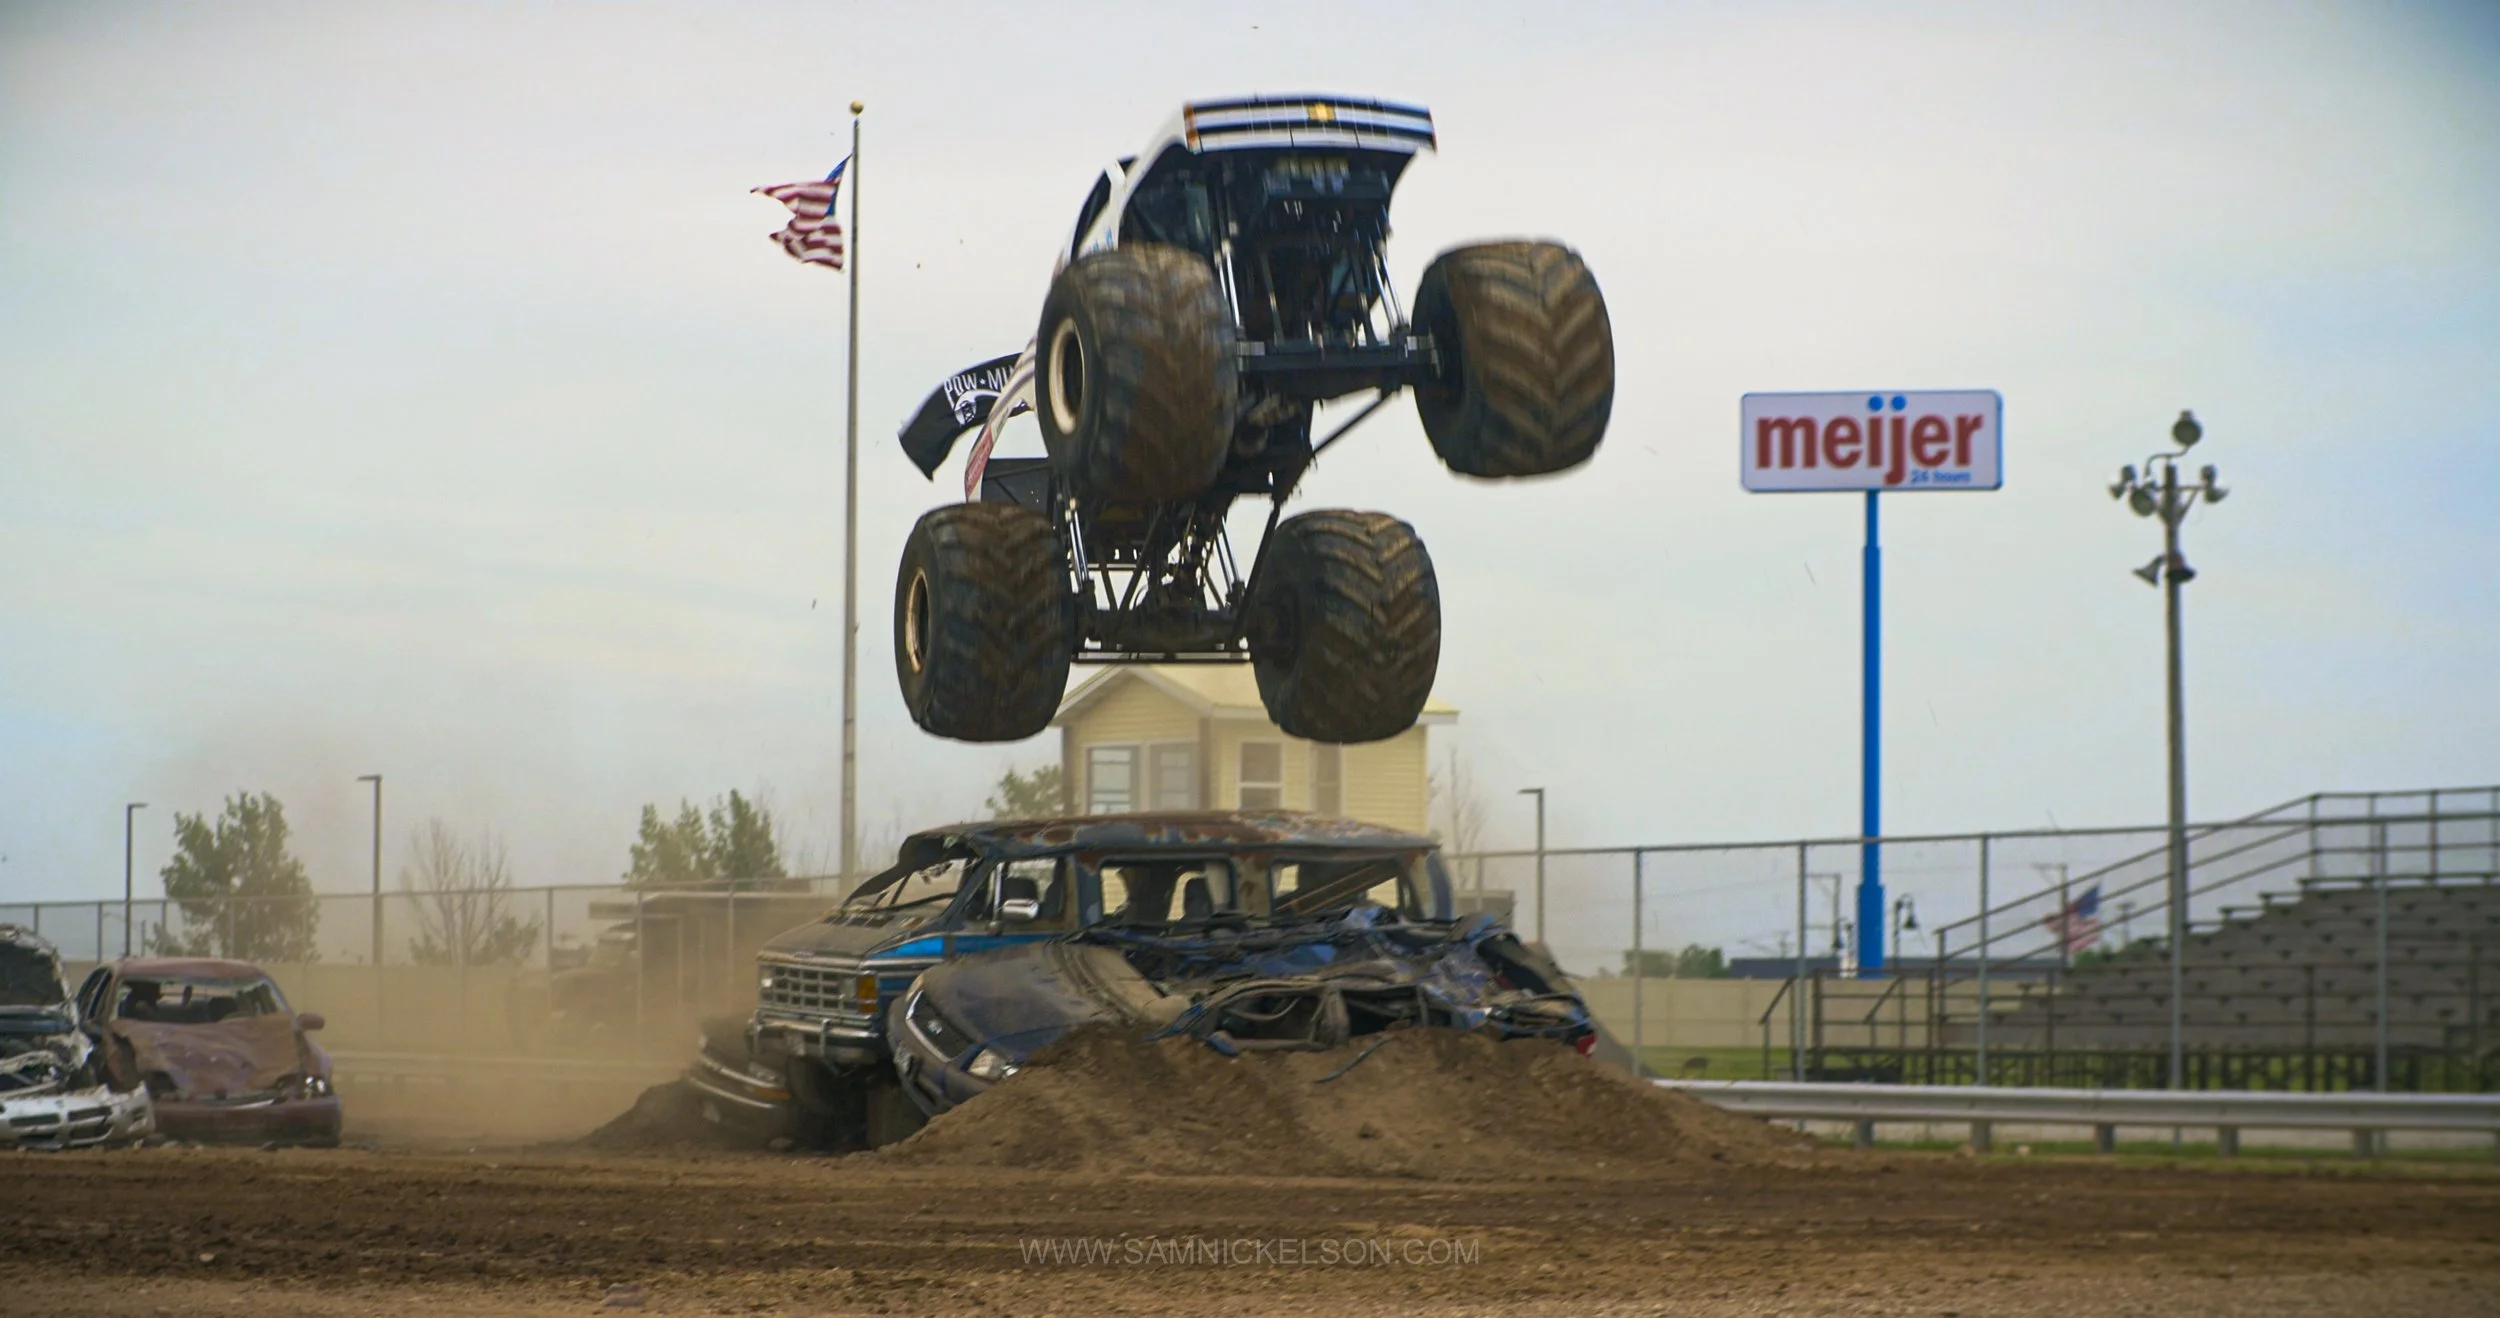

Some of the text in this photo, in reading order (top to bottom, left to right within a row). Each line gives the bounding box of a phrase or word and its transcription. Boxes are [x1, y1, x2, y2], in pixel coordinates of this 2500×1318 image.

[944, 373, 977, 409] POW
[1756, 395, 1984, 485] meijer
[1911, 469, 1929, 483] 24
